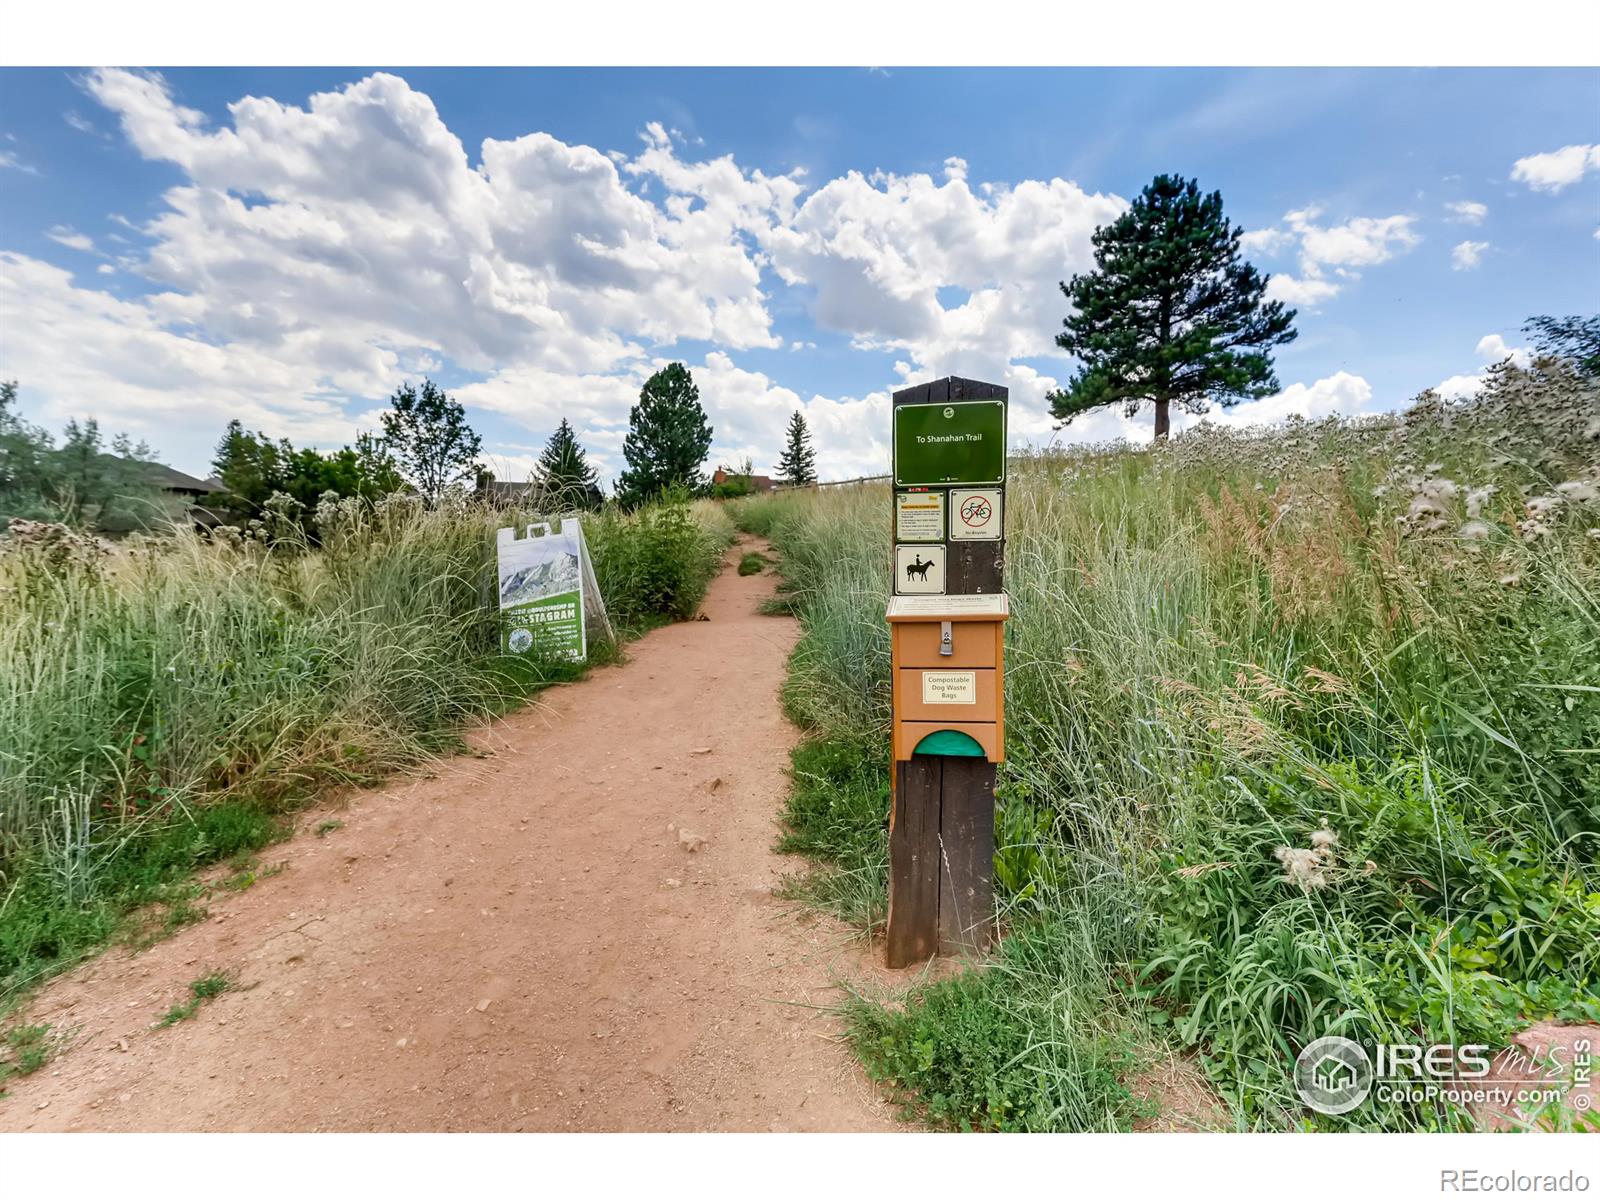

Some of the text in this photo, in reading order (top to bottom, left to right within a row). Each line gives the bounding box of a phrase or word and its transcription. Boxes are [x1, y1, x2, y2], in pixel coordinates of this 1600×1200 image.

[916, 433, 982, 443] To Shanahan Trail
[928, 676, 970, 684] Compostable
[931, 684, 945, 692] Dog
[941, 692, 957, 700] Bags
